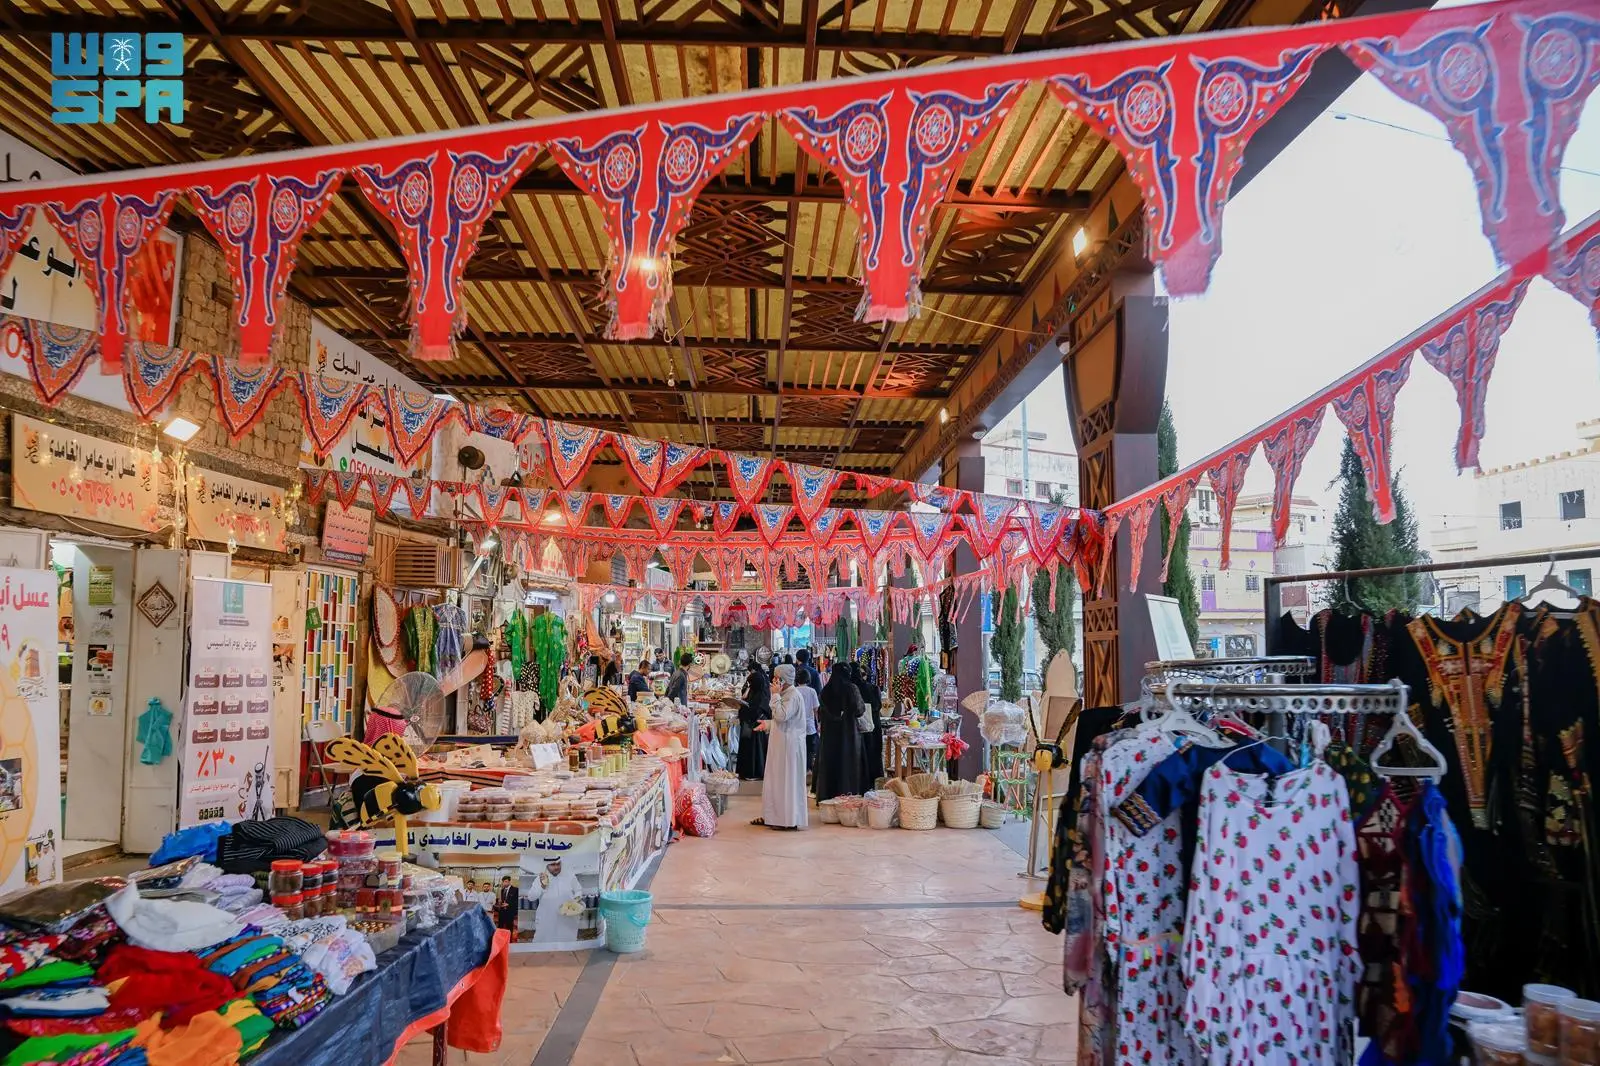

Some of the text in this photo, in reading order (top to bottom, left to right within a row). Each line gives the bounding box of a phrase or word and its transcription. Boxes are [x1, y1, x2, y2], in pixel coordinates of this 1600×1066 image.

[13, 583, 50, 611] عسل
[419, 831, 471, 852] الغامدي
[473, 833, 508, 850] عامر
[511, 832, 531, 850] أبو
[535, 835, 573, 851] محلات
